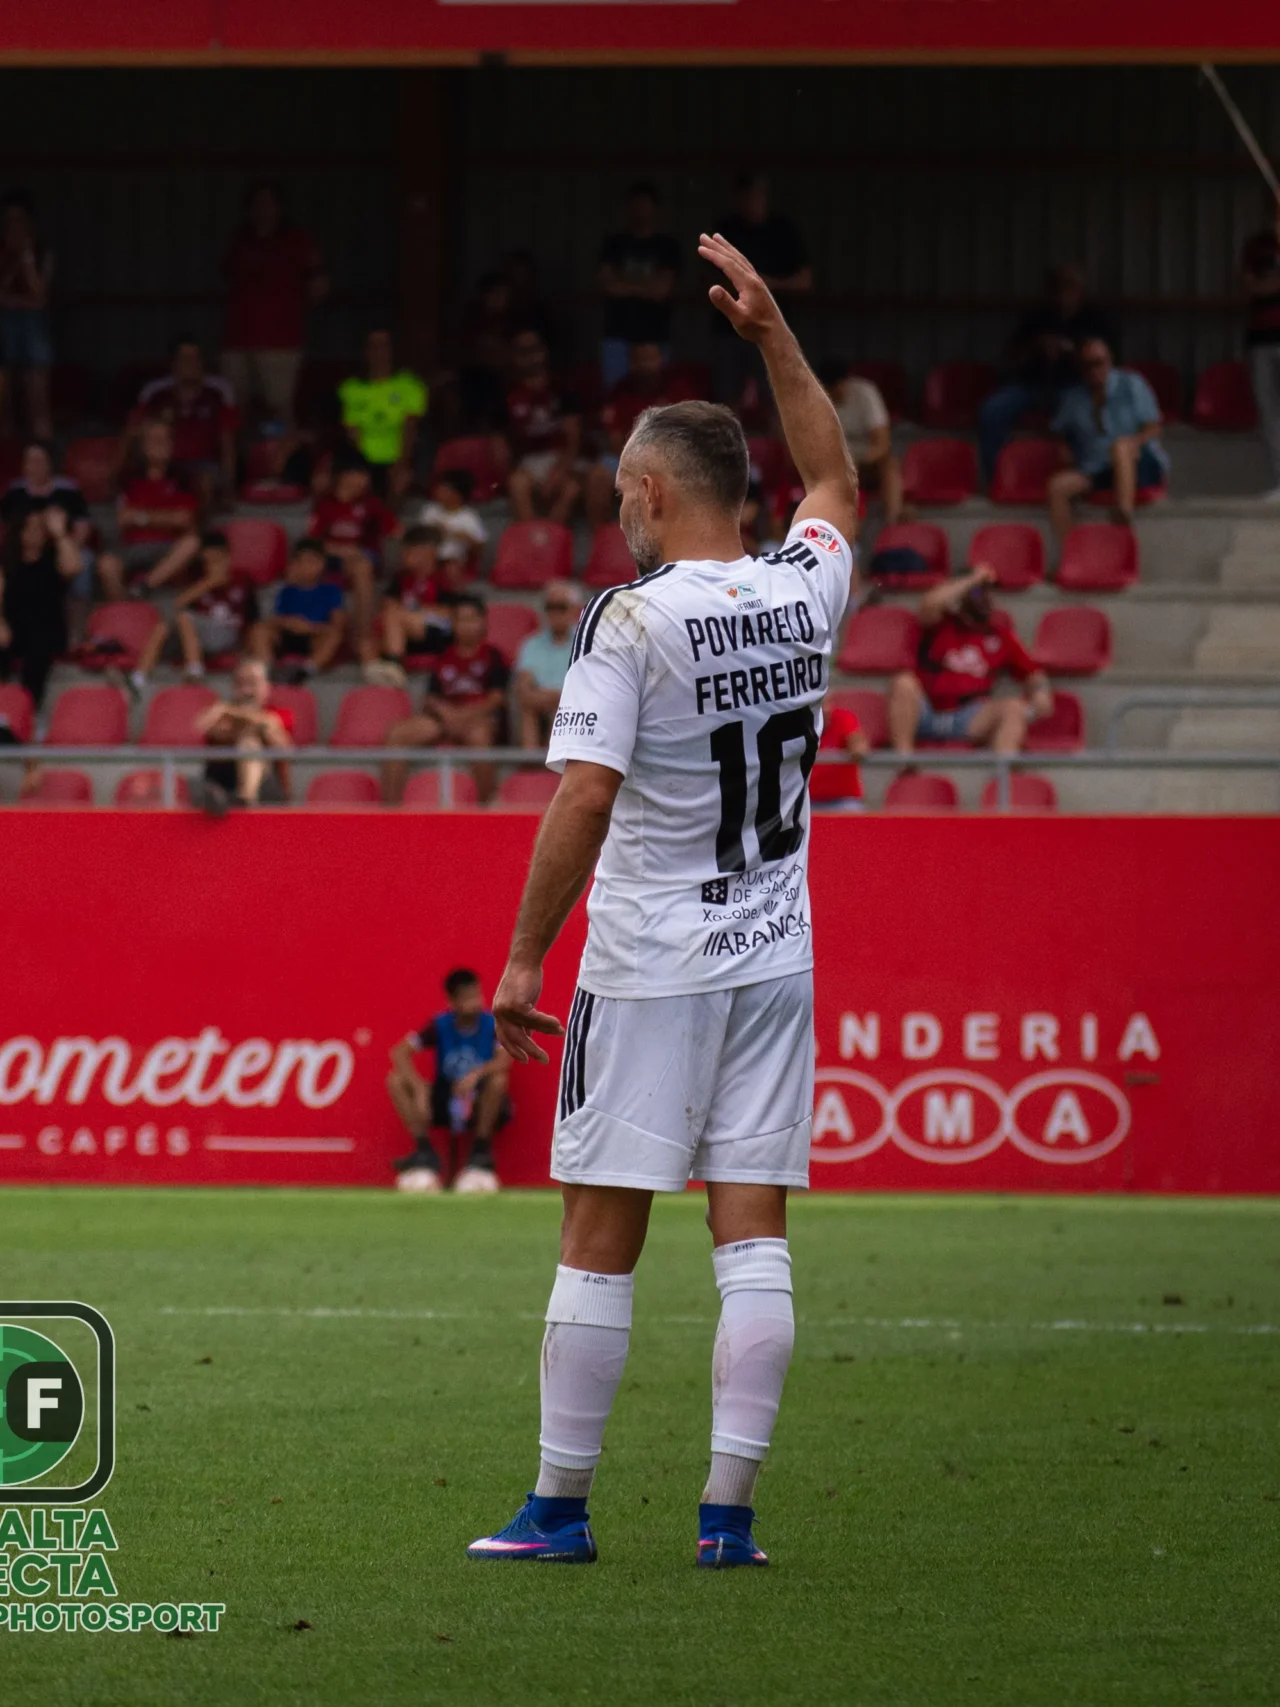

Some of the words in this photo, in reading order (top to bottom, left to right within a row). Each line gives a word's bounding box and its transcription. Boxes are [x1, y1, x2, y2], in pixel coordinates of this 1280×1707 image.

[734, 598, 763, 611] VERMUT
[684, 600, 814, 663] POVARELO
[695, 653, 822, 715] FERREIRO
[554, 711, 598, 728] asine
[710, 705, 819, 873] 10
[733, 888, 751, 903] DE
[812, 1011, 1160, 1062] NDERIA
[37, 1123, 190, 1156] CAFÉS
